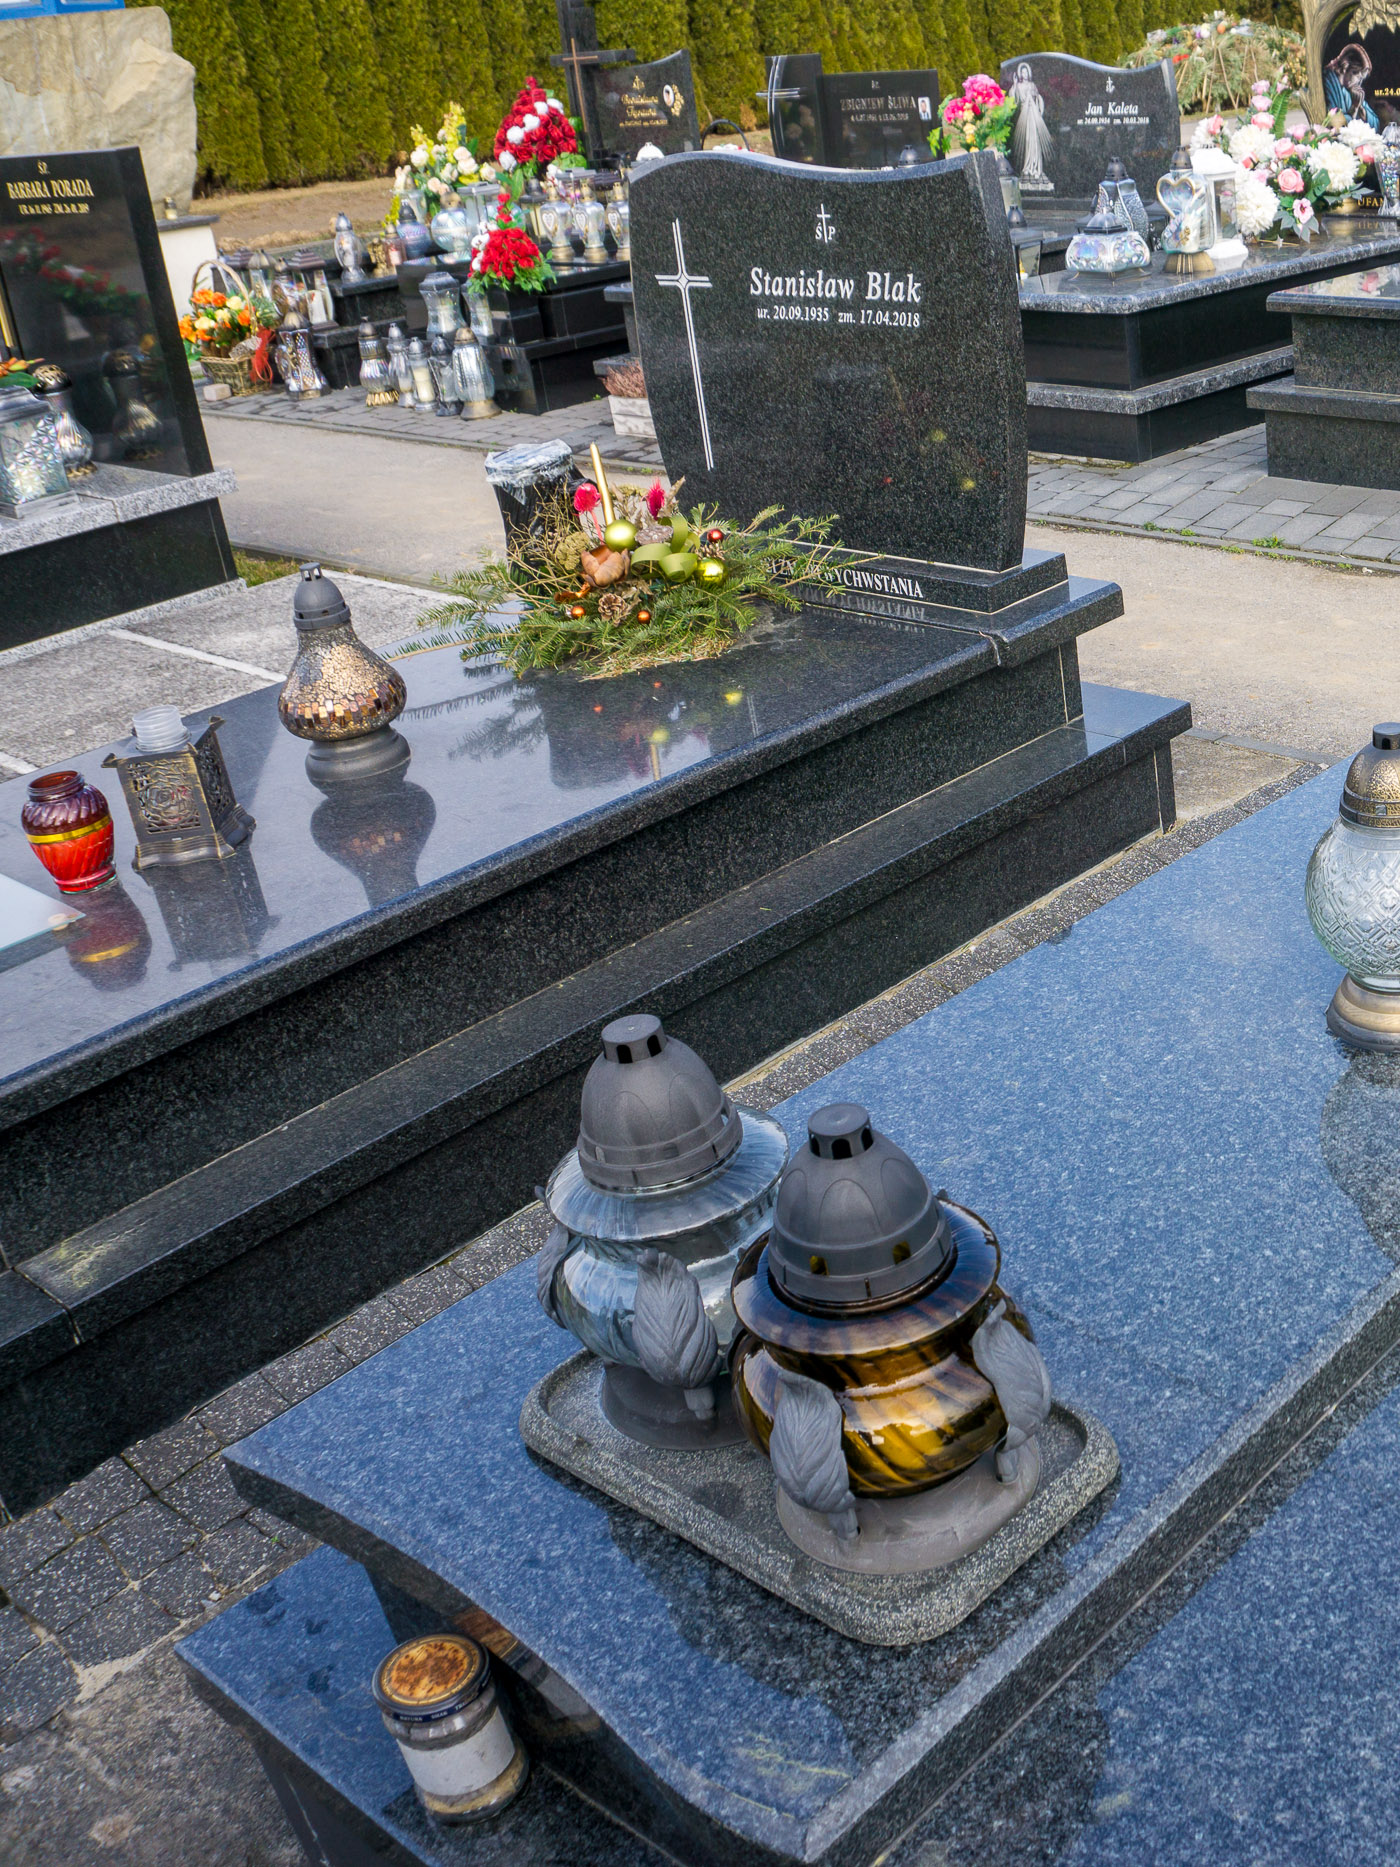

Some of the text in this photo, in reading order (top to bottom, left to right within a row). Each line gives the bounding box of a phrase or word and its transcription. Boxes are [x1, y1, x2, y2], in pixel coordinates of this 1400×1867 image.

[841, 97, 884, 110] ZBIGNIEW
[1085, 102, 1139, 115] Jan Kaleta
[6, 179, 95, 199] BARBARA PORADA
[750, 267, 922, 303] Stanisław Blak
[757, 305, 920, 327] ur. 20.09.1935 zm. 17.04.2018
